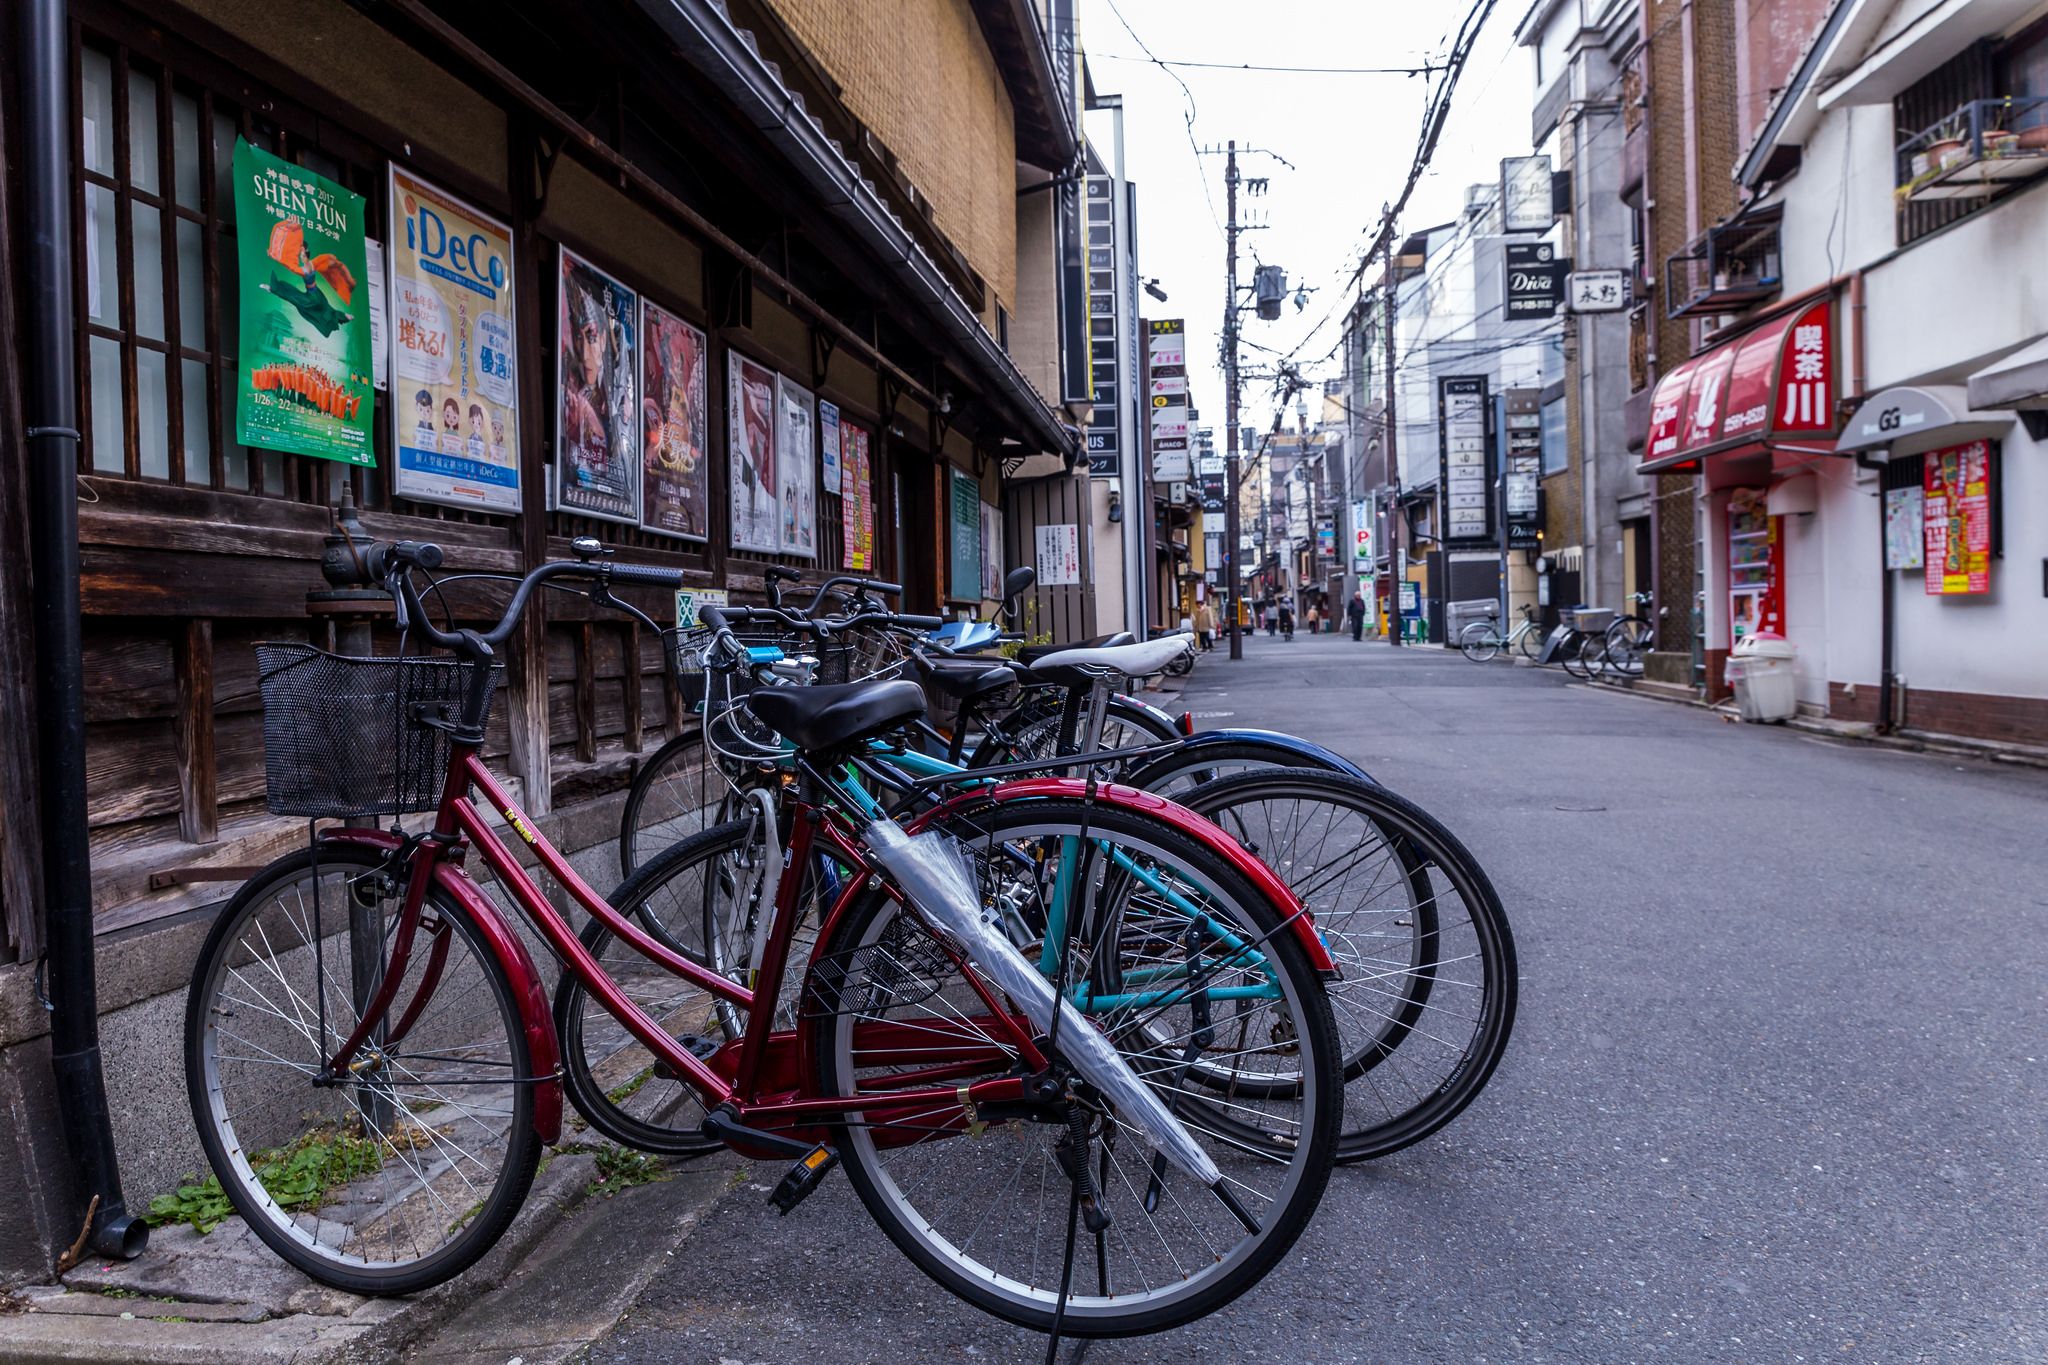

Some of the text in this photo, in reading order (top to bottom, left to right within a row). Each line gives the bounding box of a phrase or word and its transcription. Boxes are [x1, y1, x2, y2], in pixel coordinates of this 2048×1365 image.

[253, 174, 347, 233] SHEN YUN
[317, 188, 335, 206] 2017
[404, 194, 504, 289] iDeCo
[1509, 272, 1553, 291] Diva
[408, 307, 438, 323] もうひとつ
[399, 317, 446, 358] 増える!
[480, 345, 512, 380] 優遇!
[1783, 325, 1825, 425] 喫茶川
[253, 392, 271, 406] 1/26
[1879, 407, 1901, 432] GG
[479, 464, 498, 479] iDeCo
[1357, 531, 1370, 544] P
